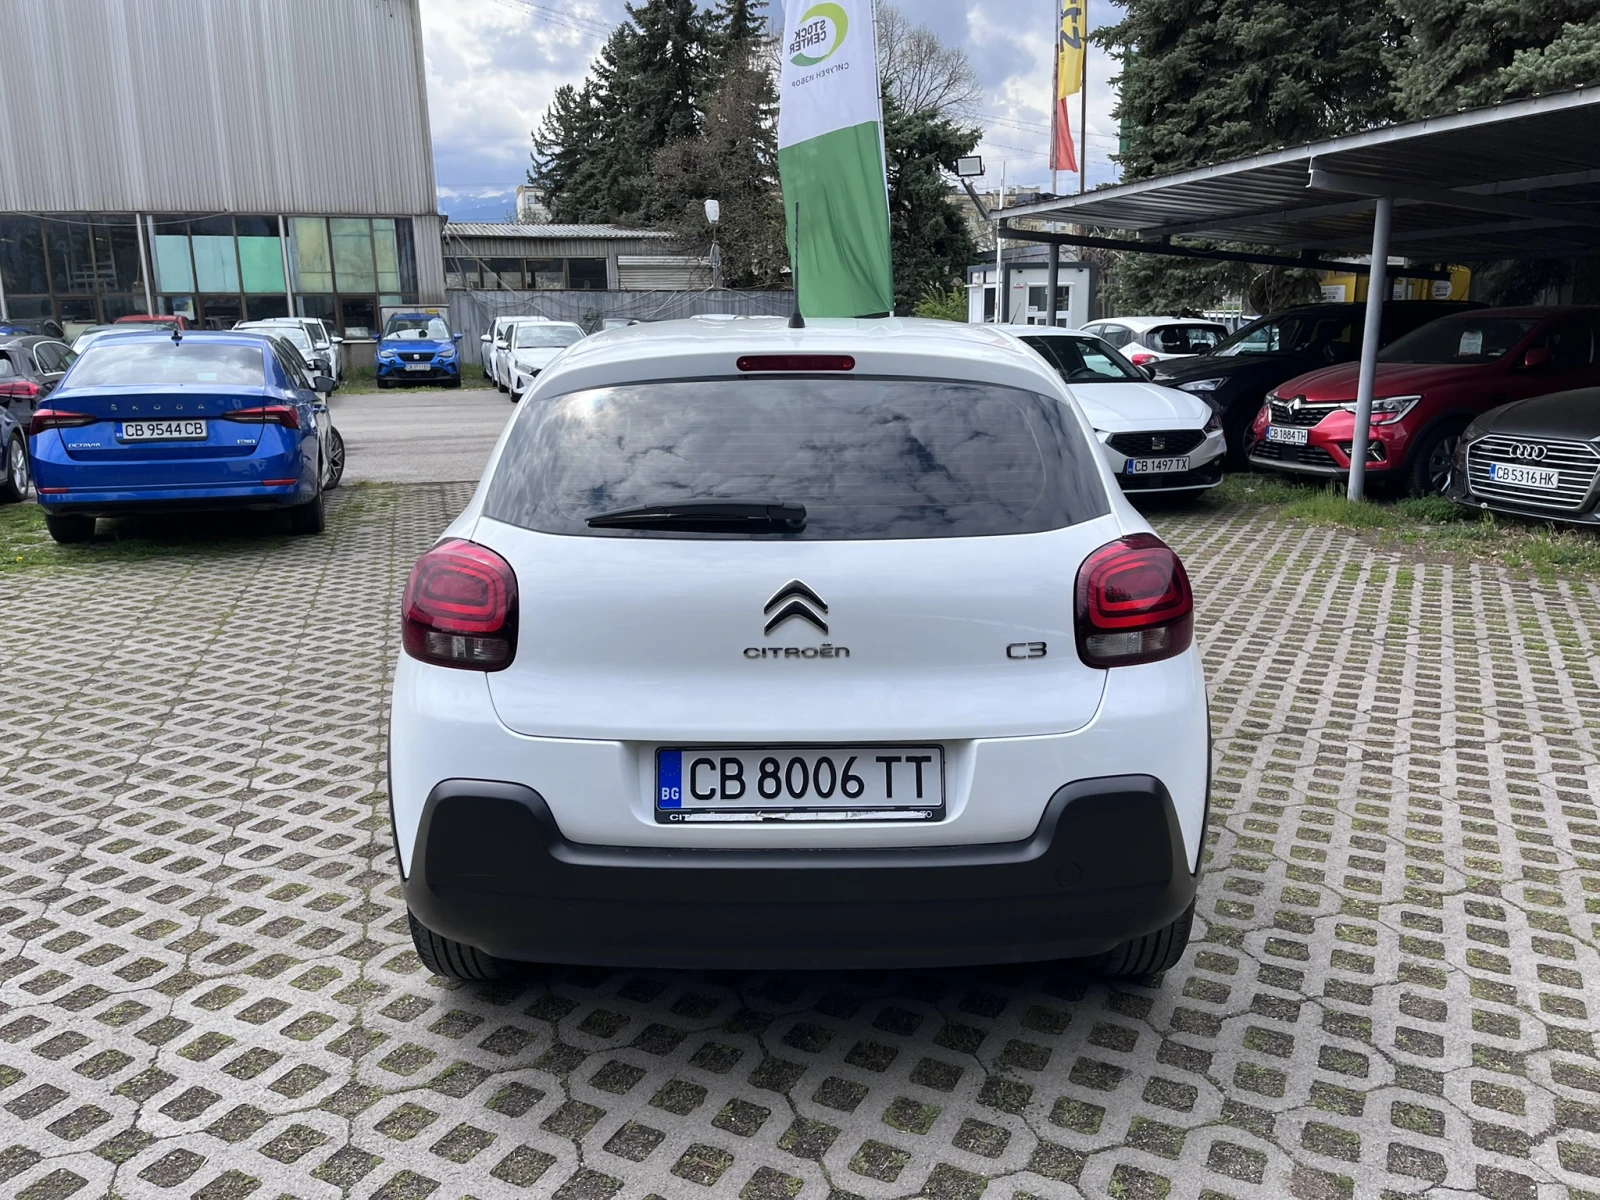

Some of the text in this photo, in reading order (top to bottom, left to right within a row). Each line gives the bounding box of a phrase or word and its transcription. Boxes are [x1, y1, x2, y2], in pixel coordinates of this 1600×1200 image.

[125, 424, 144, 437] CB
[147, 423, 182, 436] 9544
[185, 422, 204, 435] CB
[1280, 429, 1295, 440] 1884
[1135, 458, 1188, 472] CB 1497 TX
[1496, 466, 1555, 486] CB 5316 HK
[743, 641, 850, 659] CITROËN
[1006, 641, 1047, 660] C3
[689, 755, 932, 800] CB 8006 TT
[661, 787, 680, 801] BG
